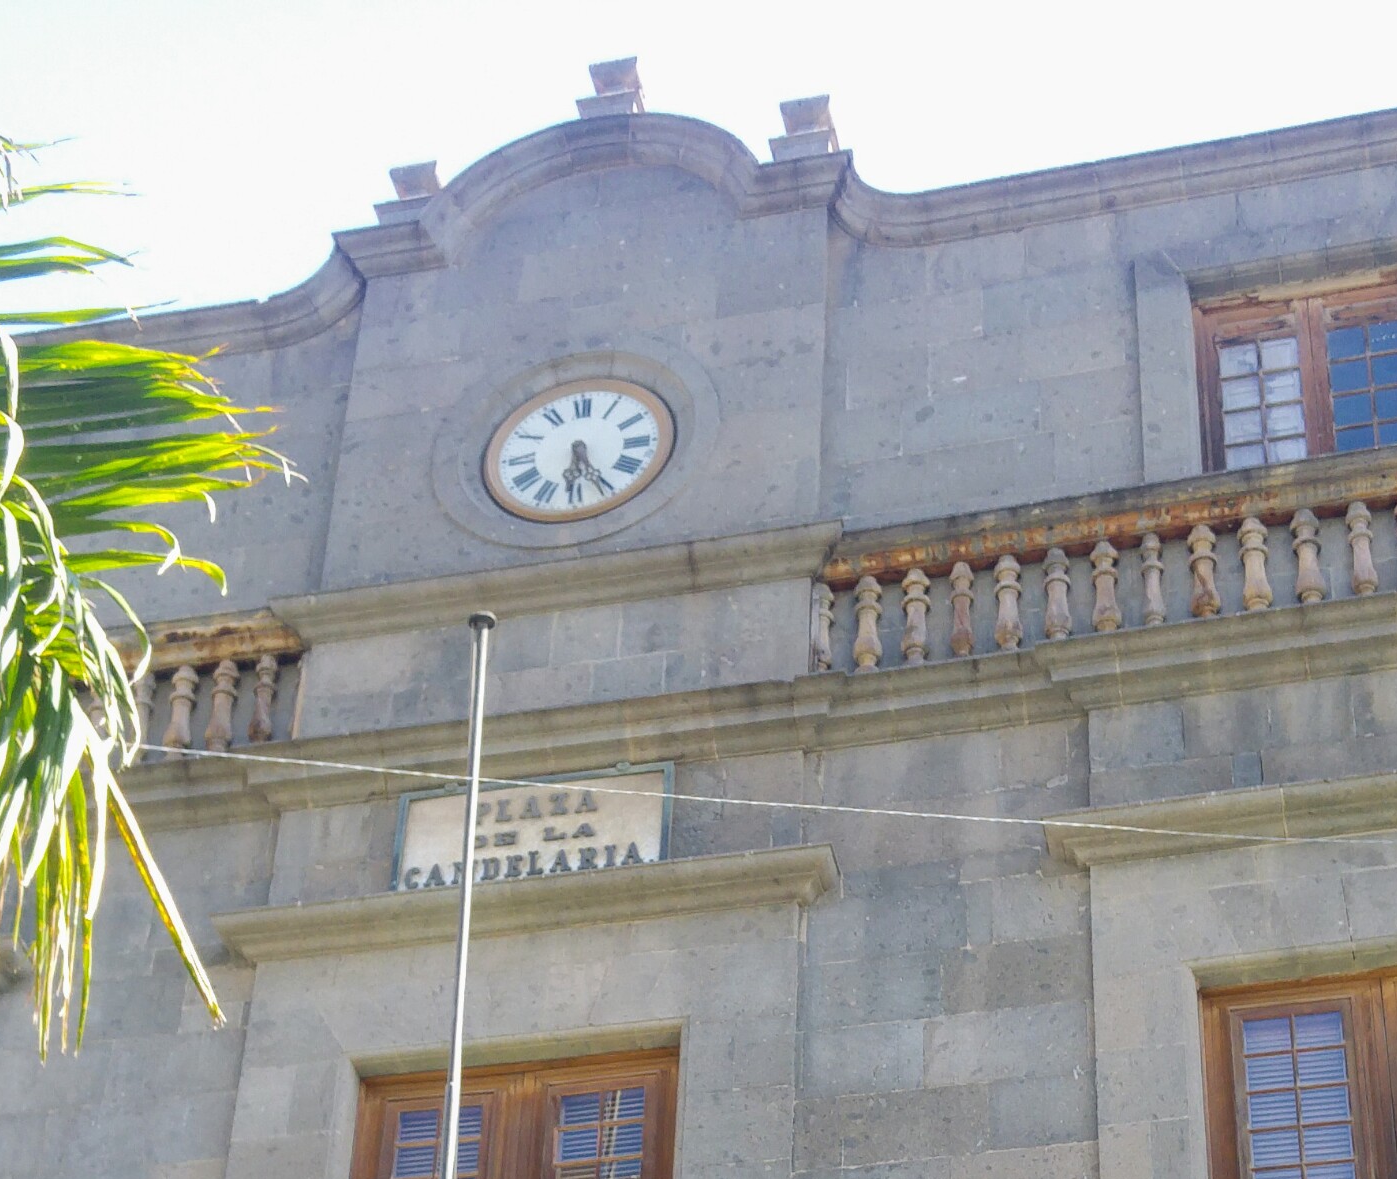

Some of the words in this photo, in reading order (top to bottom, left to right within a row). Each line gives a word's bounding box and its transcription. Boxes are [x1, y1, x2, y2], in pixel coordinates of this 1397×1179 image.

[616, 411, 643, 431] II
[623, 434, 650, 449] III
[474, 790, 599, 826] PLAZA
[543, 822, 596, 842] LA
